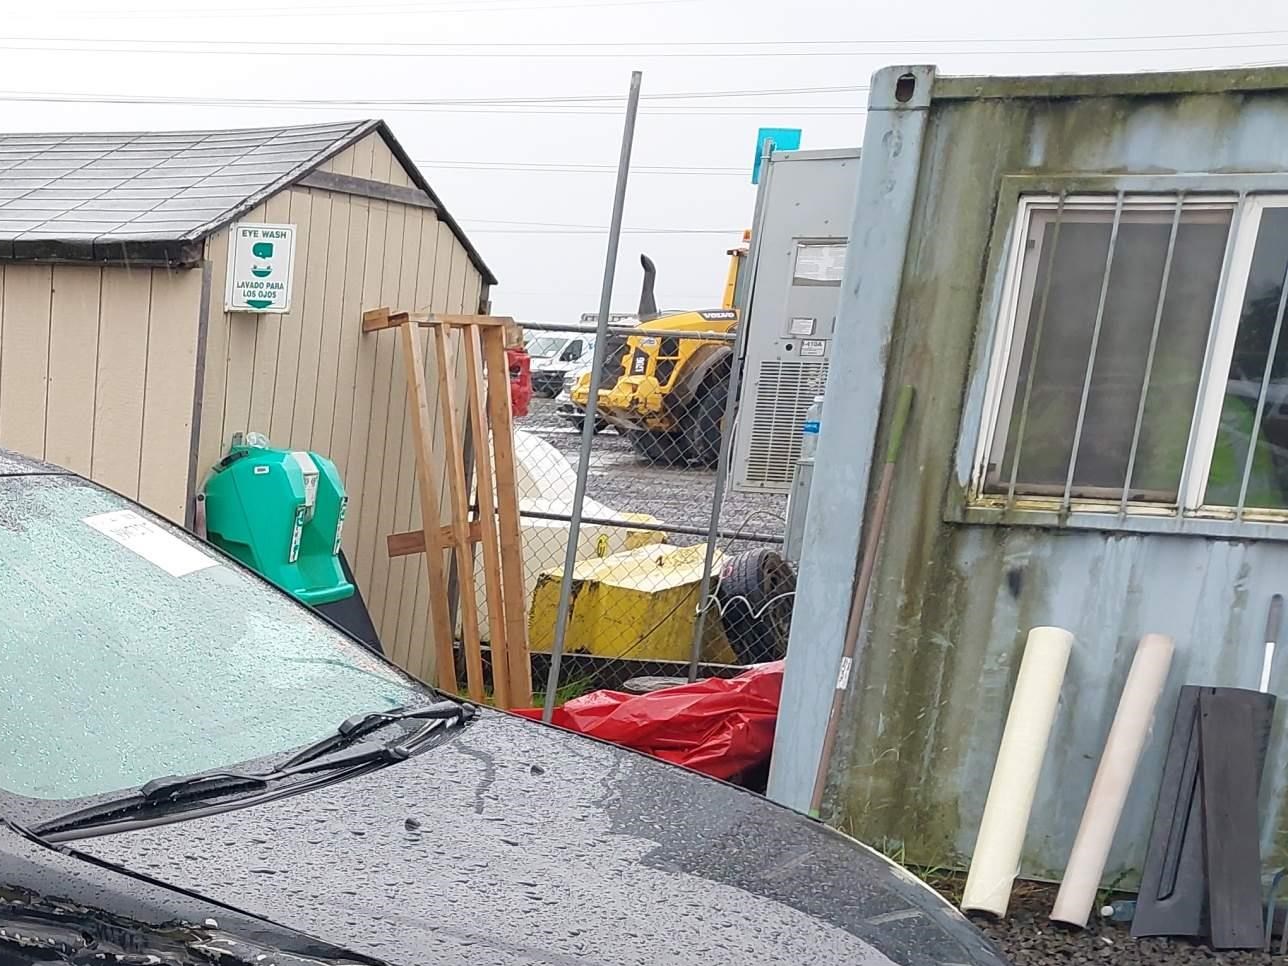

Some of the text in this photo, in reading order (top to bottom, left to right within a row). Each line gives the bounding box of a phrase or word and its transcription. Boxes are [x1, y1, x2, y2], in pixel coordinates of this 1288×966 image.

[242, 229, 287, 239] EYE WASH
[236, 281, 284, 290] LAVADO PARA
[242, 290, 277, 298] LOS OJOS
